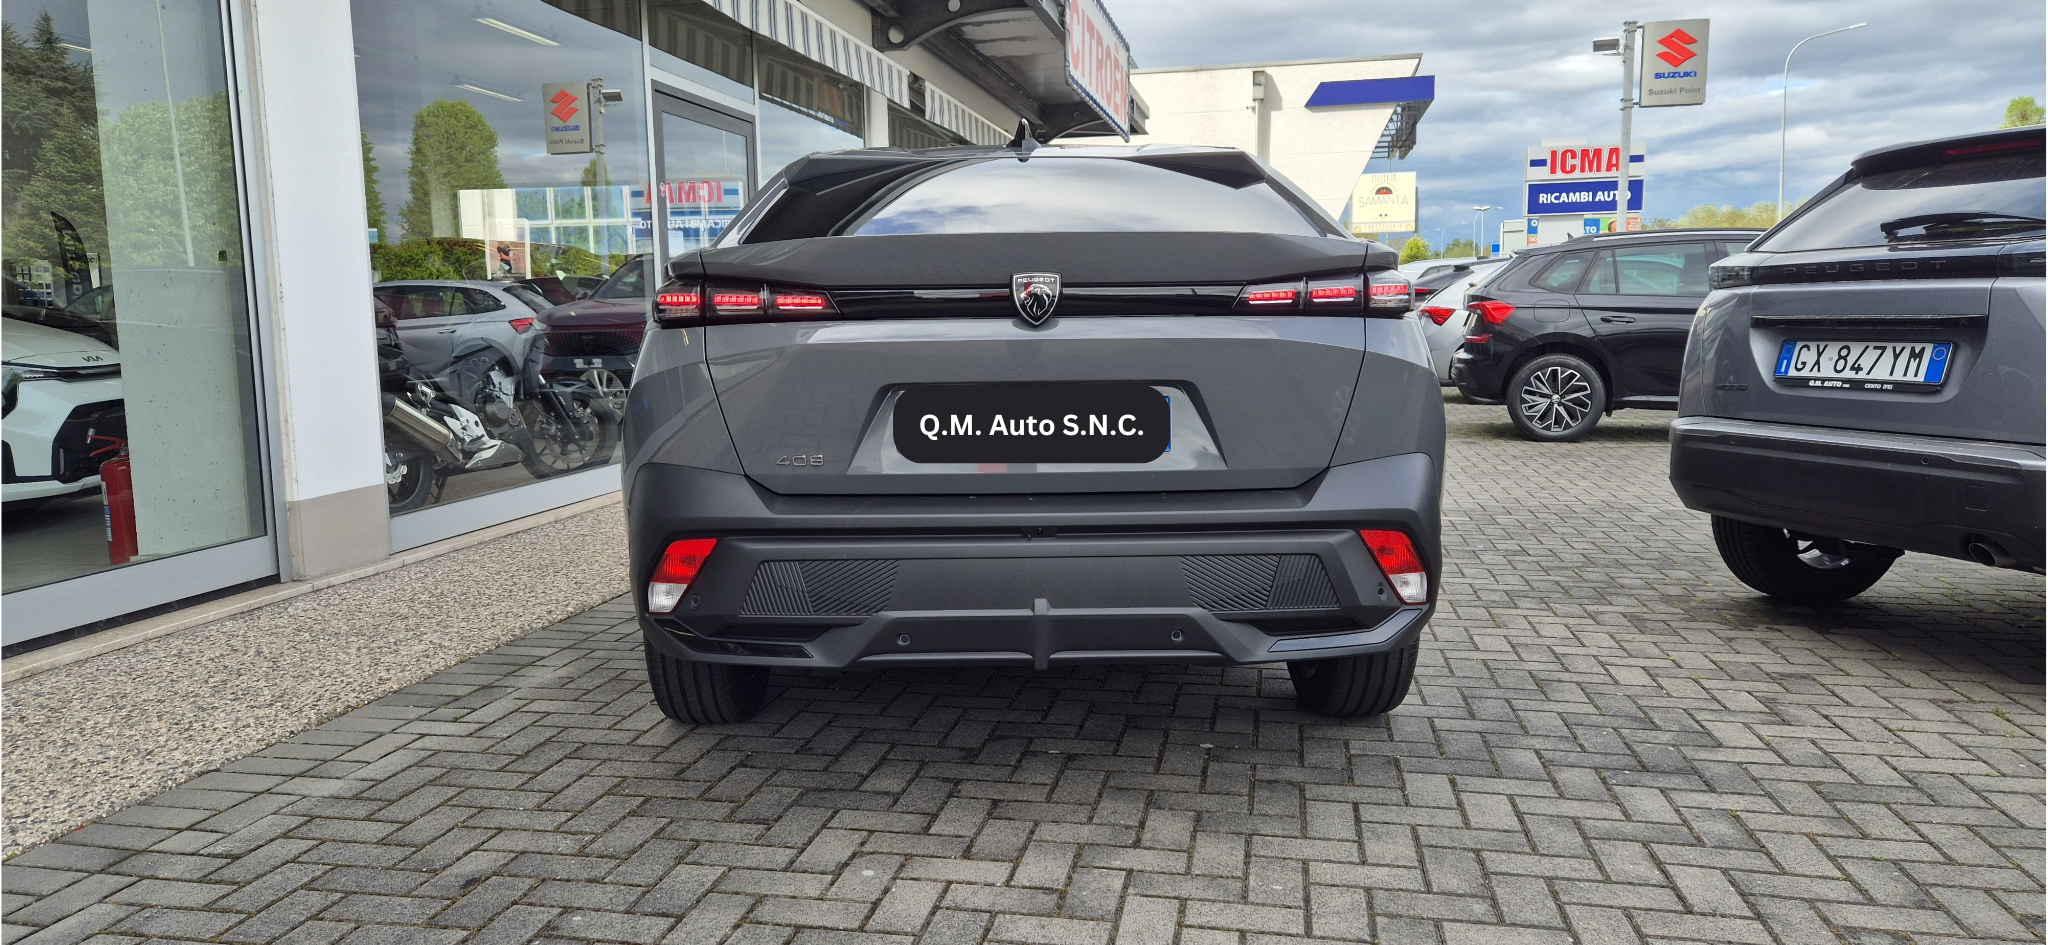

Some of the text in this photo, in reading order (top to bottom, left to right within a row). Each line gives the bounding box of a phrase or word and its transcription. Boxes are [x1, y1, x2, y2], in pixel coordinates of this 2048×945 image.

[1069, 0, 1128, 124] CITROËN
[1654, 71, 1697, 79] SUZUKI
[1549, 147, 1621, 175] ICMA
[1359, 194, 1409, 208] SAMANTA
[1539, 191, 1593, 204] RICAMBI
[1784, 260, 1947, 275] PEUGEOT
[1794, 344, 1926, 378] GX 847YM
[775, 454, 824, 466] 408
